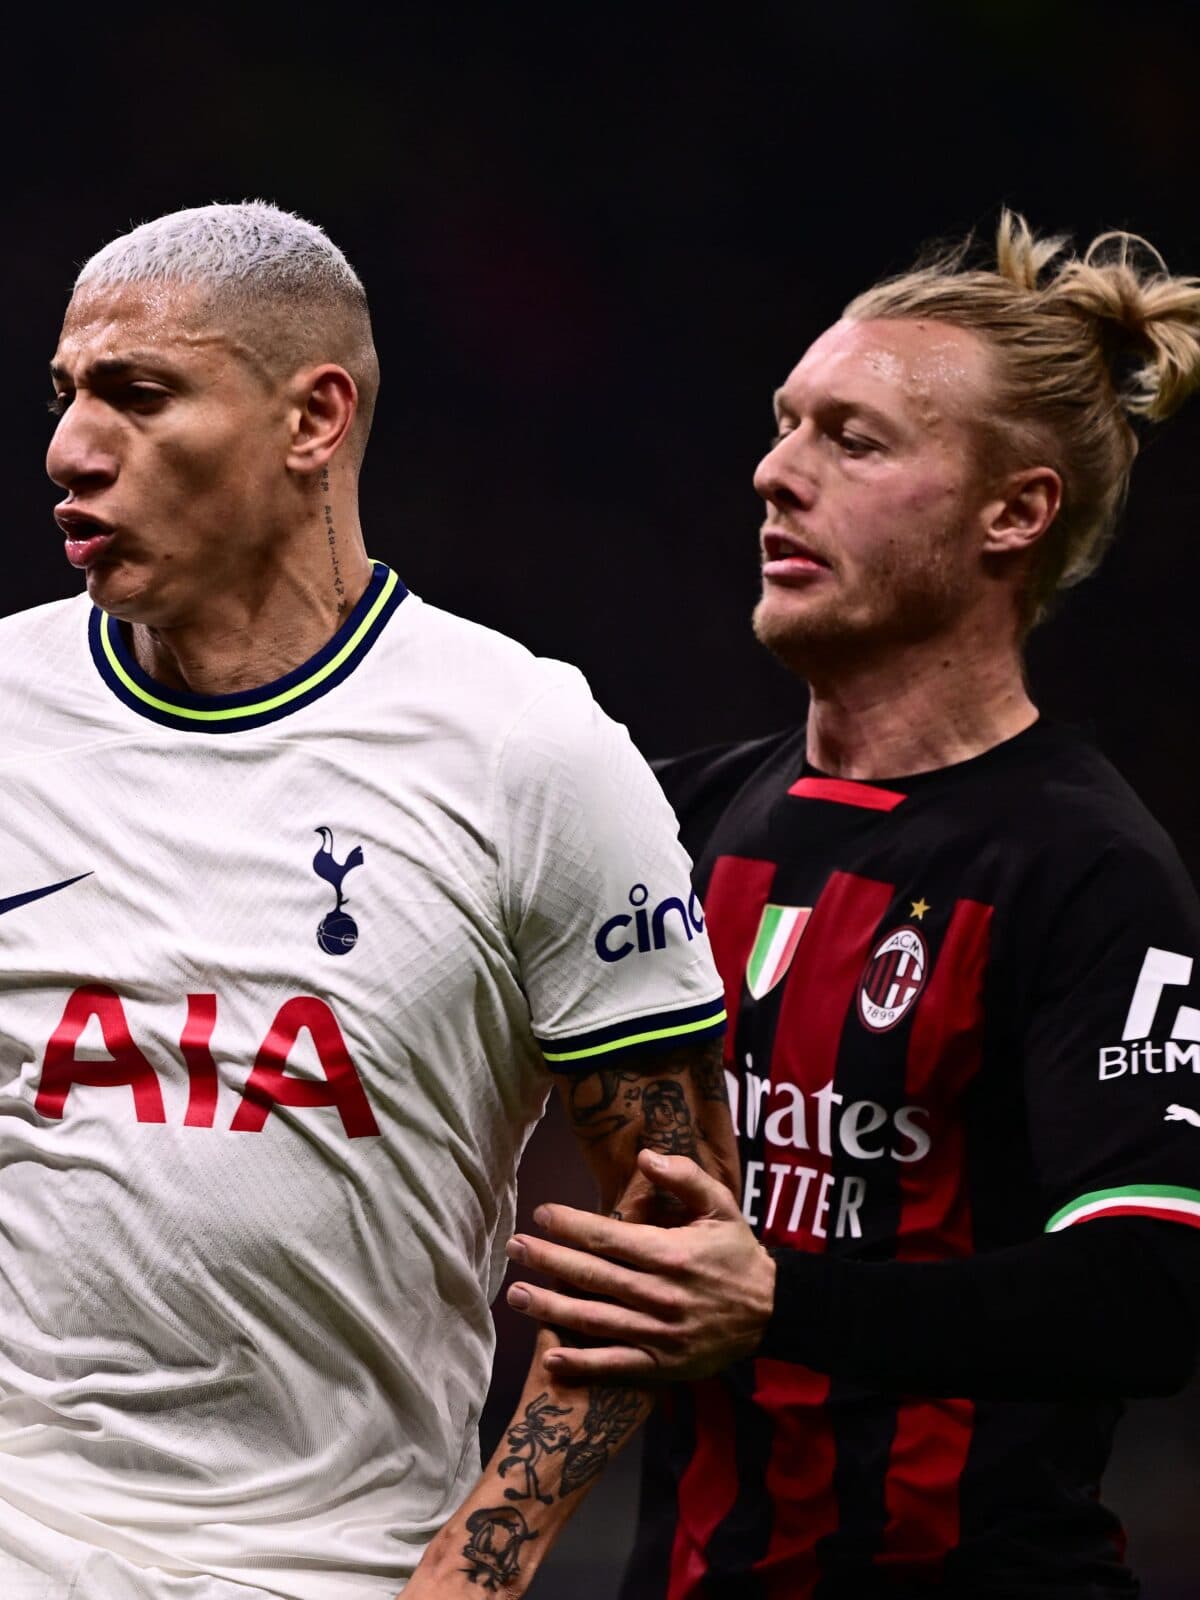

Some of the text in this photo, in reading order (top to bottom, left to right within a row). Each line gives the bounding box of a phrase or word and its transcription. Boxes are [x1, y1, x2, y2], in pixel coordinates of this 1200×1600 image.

[865, 1005, 896, 1021] 1899
[34, 983, 381, 1139] AIA
[1099, 1041, 1200, 1081] BitM
